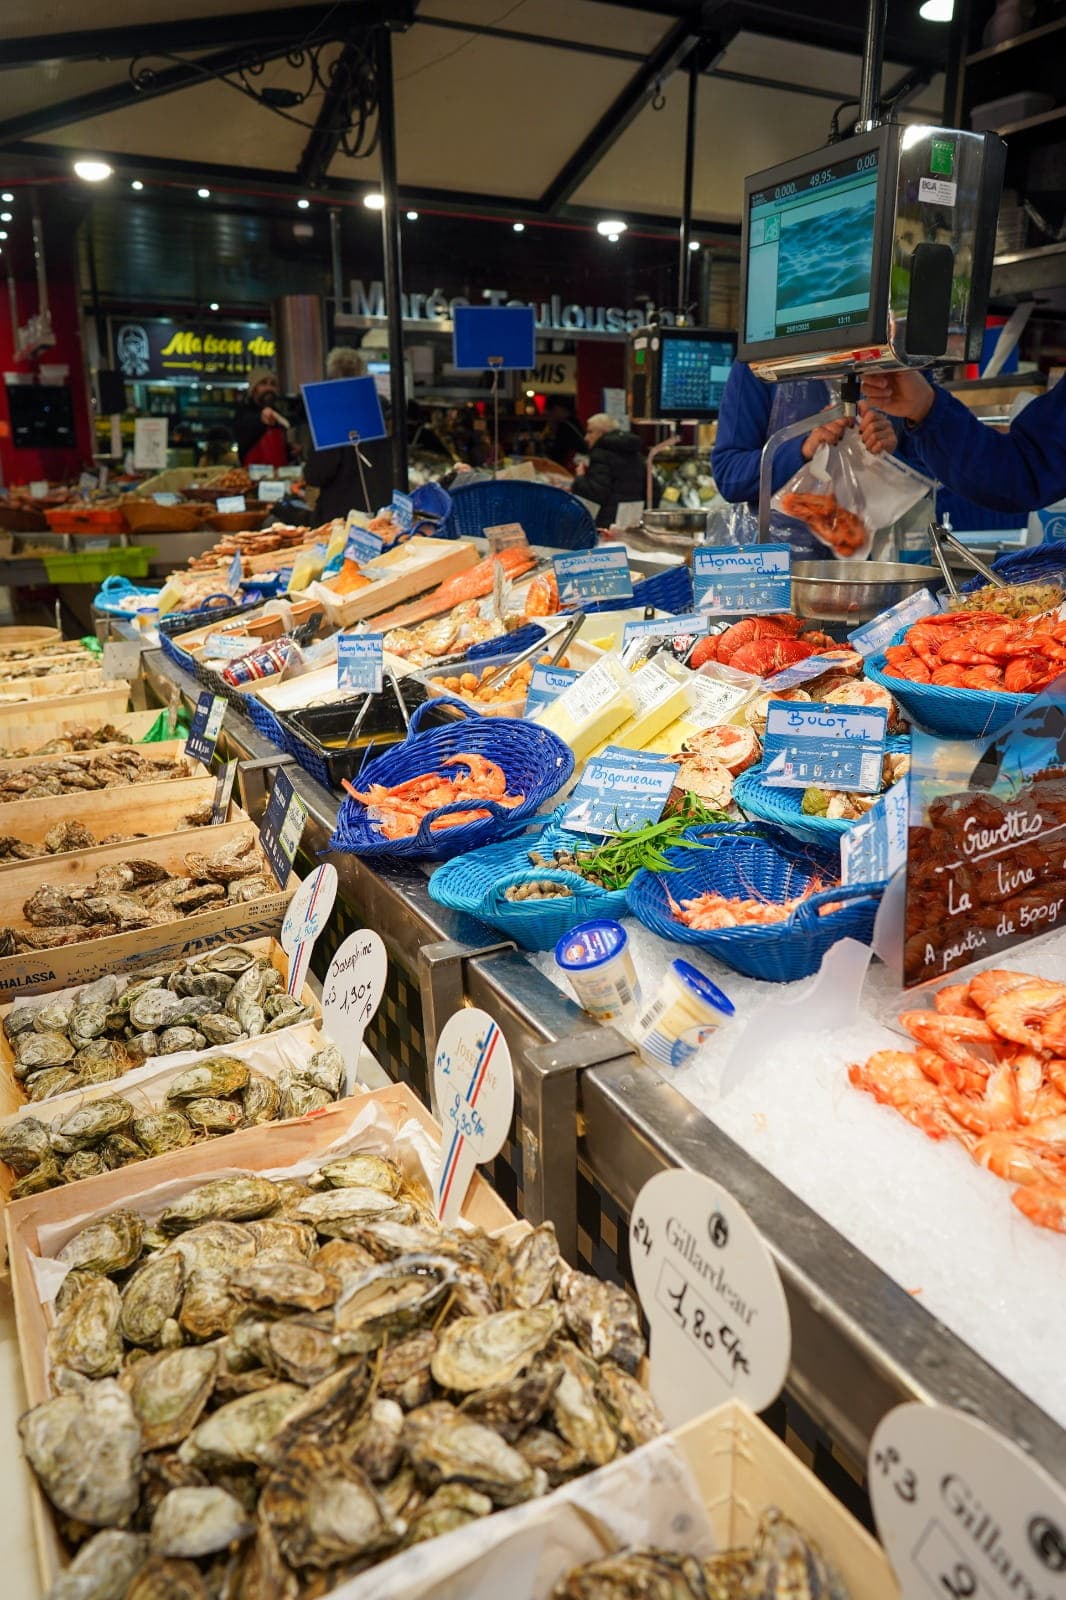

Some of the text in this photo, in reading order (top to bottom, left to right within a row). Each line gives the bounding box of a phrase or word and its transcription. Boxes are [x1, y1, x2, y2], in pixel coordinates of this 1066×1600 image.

[482, 289, 694, 332] Tulousain
[161, 331, 243, 356] Maison
[787, 710, 848, 728] BULOT
[949, 879, 972, 915] La
[924, 943, 936, 965] A
[996, 915, 1016, 938] de
[940, 1473, 1058, 1600] Gillar
